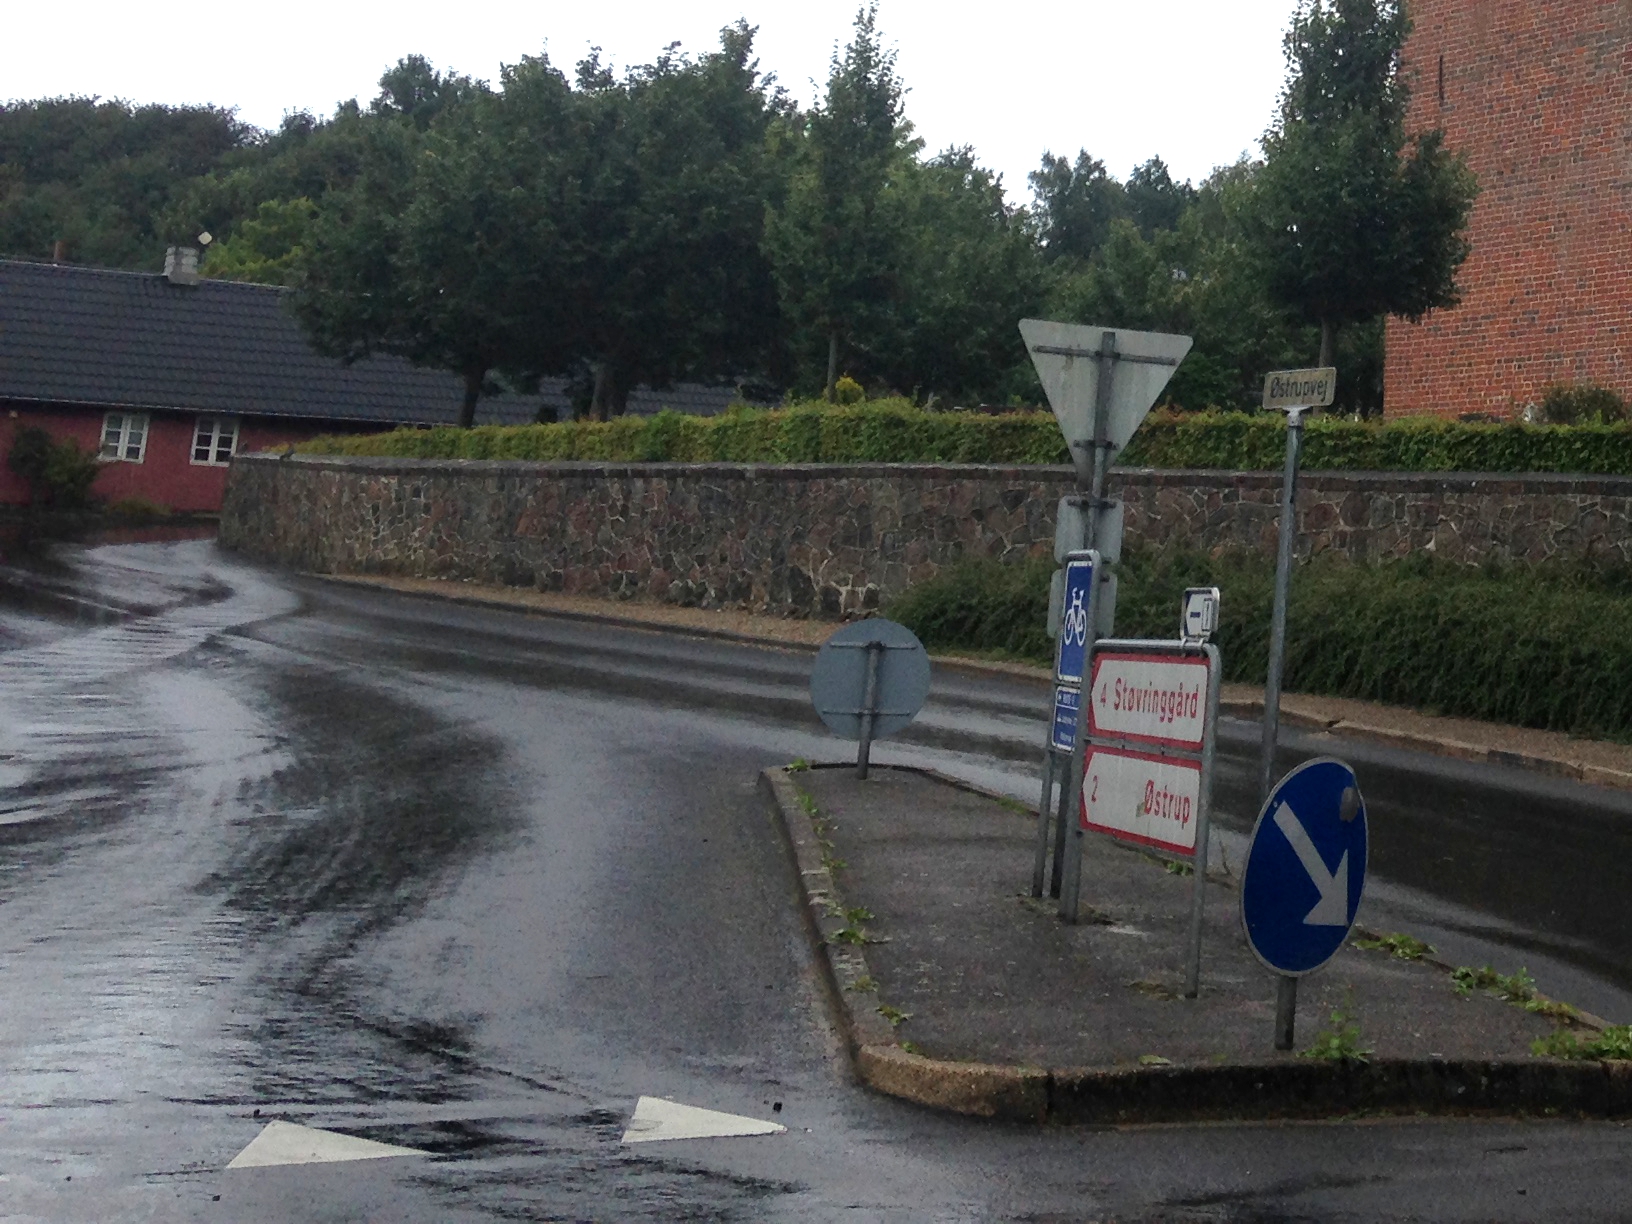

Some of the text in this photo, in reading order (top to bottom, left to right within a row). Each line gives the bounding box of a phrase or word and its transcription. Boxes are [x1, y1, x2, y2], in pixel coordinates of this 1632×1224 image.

[1269, 374, 1329, 404] Østrupvej
[1100, 677, 1199, 723] 4 Støvringgård
[1091, 775, 1190, 830] 2 Østrup
